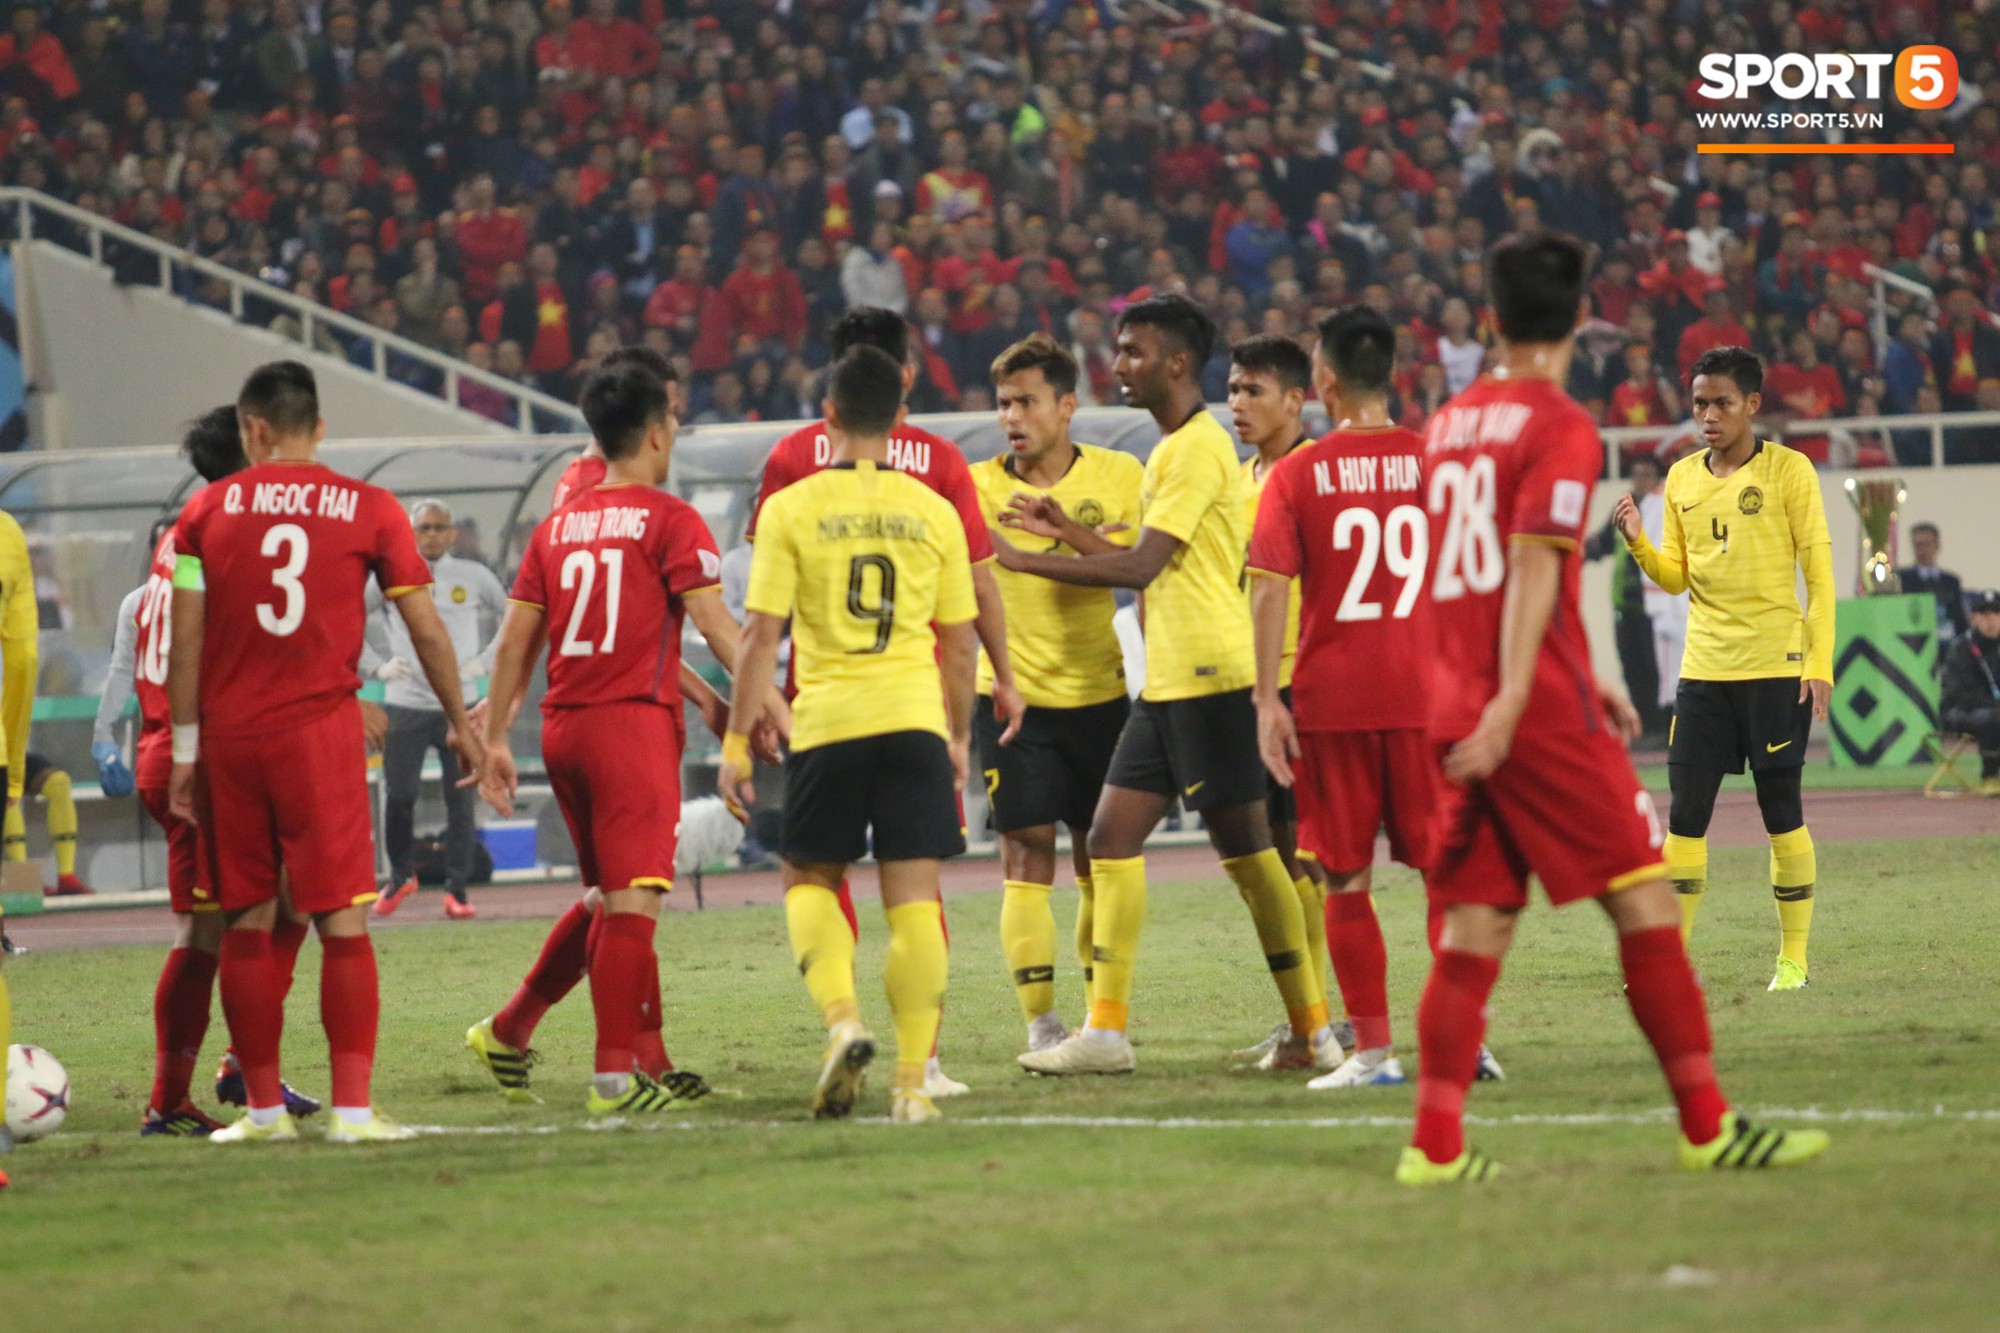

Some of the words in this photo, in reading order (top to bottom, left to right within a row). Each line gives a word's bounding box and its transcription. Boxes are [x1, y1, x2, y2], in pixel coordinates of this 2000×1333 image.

[886, 437, 932, 475] HAU
[1313, 460, 1337, 497] N.
[1337, 456, 1379, 494] HUY
[223, 482, 245, 514] Q.
[251, 482, 317, 516] NGOC
[317, 484, 360, 523] HAI
[561, 509, 602, 545] DINH
[598, 505, 651, 541] TRONG
[1428, 453, 1506, 602] 28
[1711, 516, 1729, 554] 4
[255, 522, 310, 637] 3
[1332, 504, 1430, 623] 29
[559, 547, 624, 657] 21
[847, 552, 897, 656] 9
